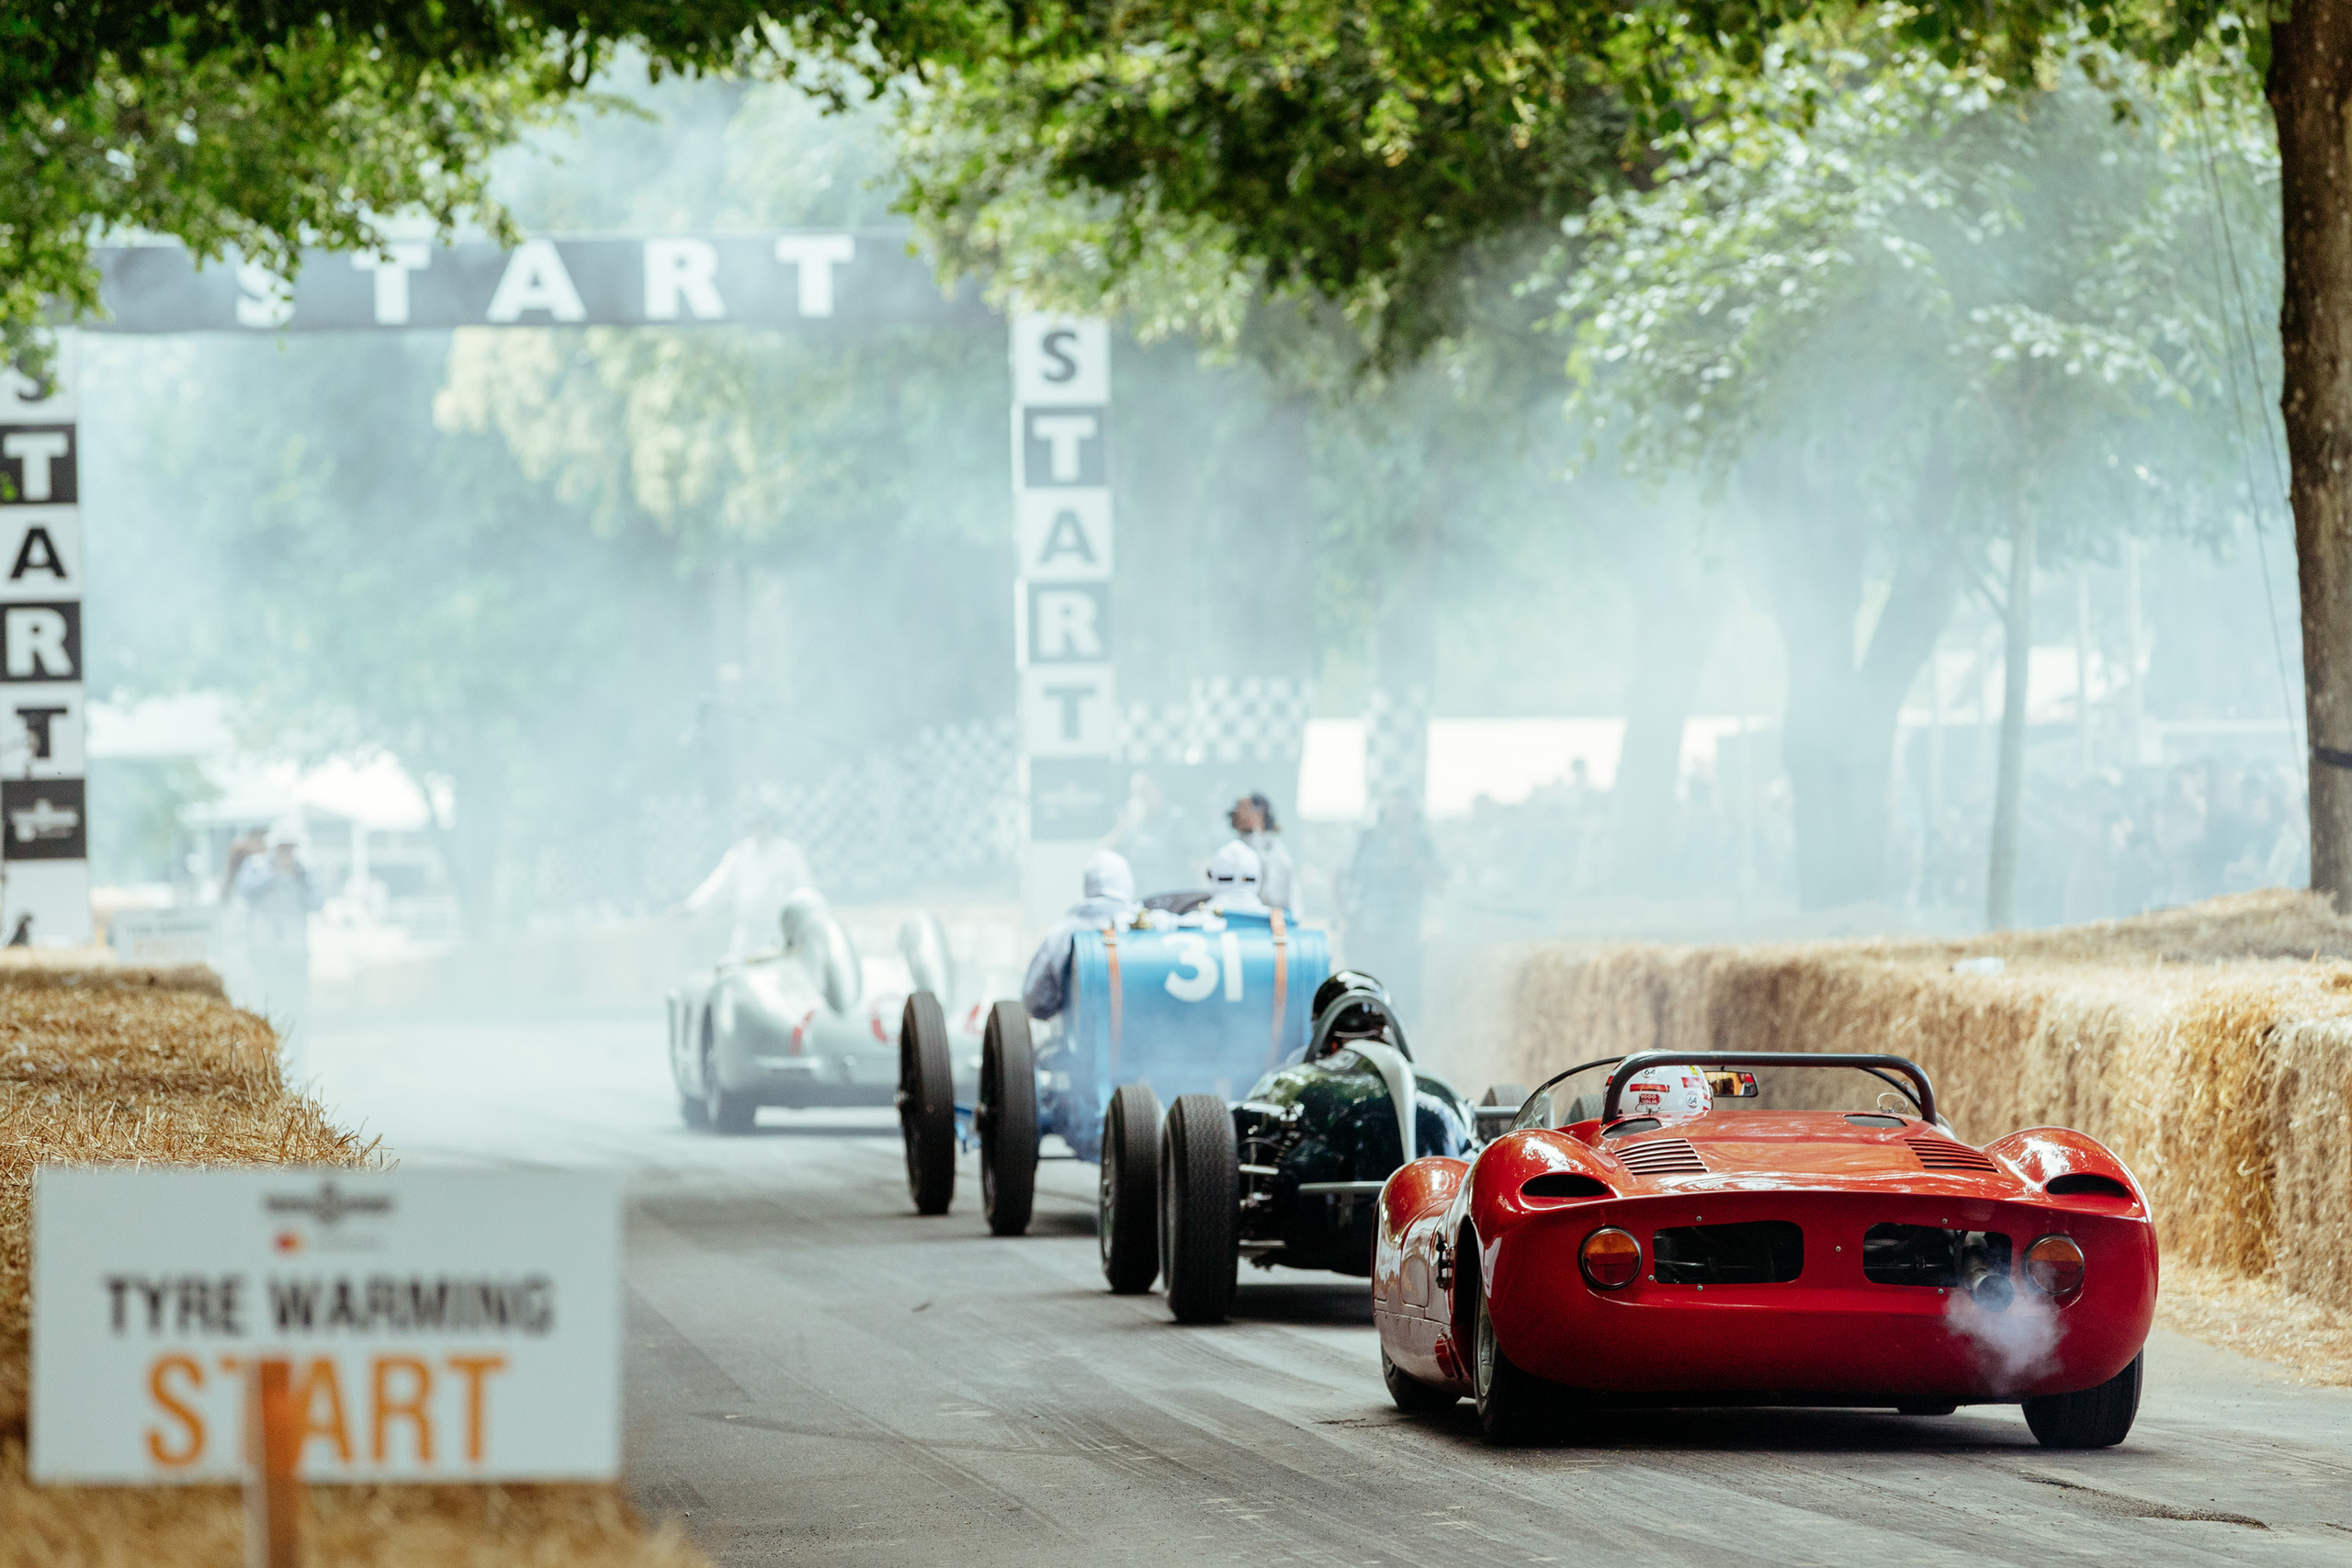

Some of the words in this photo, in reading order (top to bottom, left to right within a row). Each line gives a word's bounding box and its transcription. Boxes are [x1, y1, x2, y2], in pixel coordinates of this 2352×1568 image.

[235, 235, 855, 328] START
[1033, 331, 1103, 740] START
[1162, 931, 1244, 1003] 31
[104, 1273, 246, 1337] TYRE
